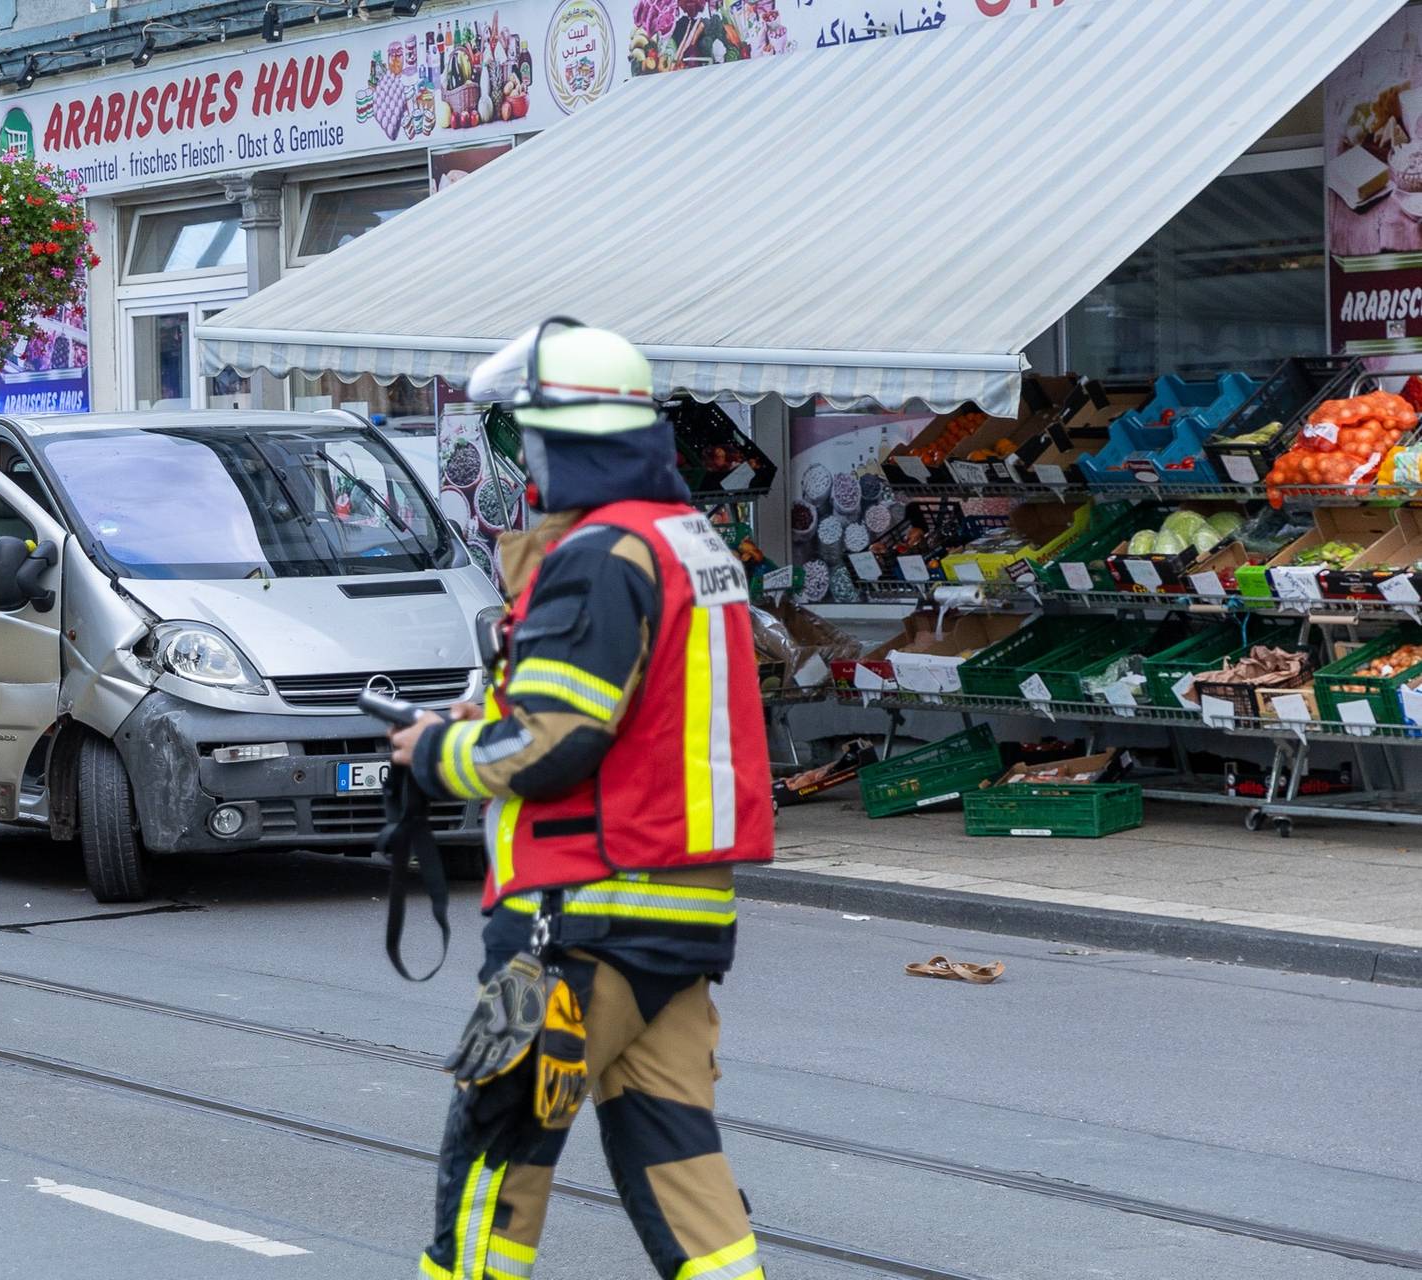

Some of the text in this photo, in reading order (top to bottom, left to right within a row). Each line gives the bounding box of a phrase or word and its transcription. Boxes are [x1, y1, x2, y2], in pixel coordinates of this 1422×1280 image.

[43, 49, 350, 153] ARABISCHES HAUS
[129, 146, 178, 177] frisches
[181, 141, 225, 169] Fleisch
[237, 132, 268, 162] Obst
[272, 128, 285, 153] &
[289, 119, 344, 151] Gemüse
[1341, 286, 1422, 322] ARABISC
[4, 390, 84, 414] ARABISCHES HAUS
[351, 766, 364, 786] E
